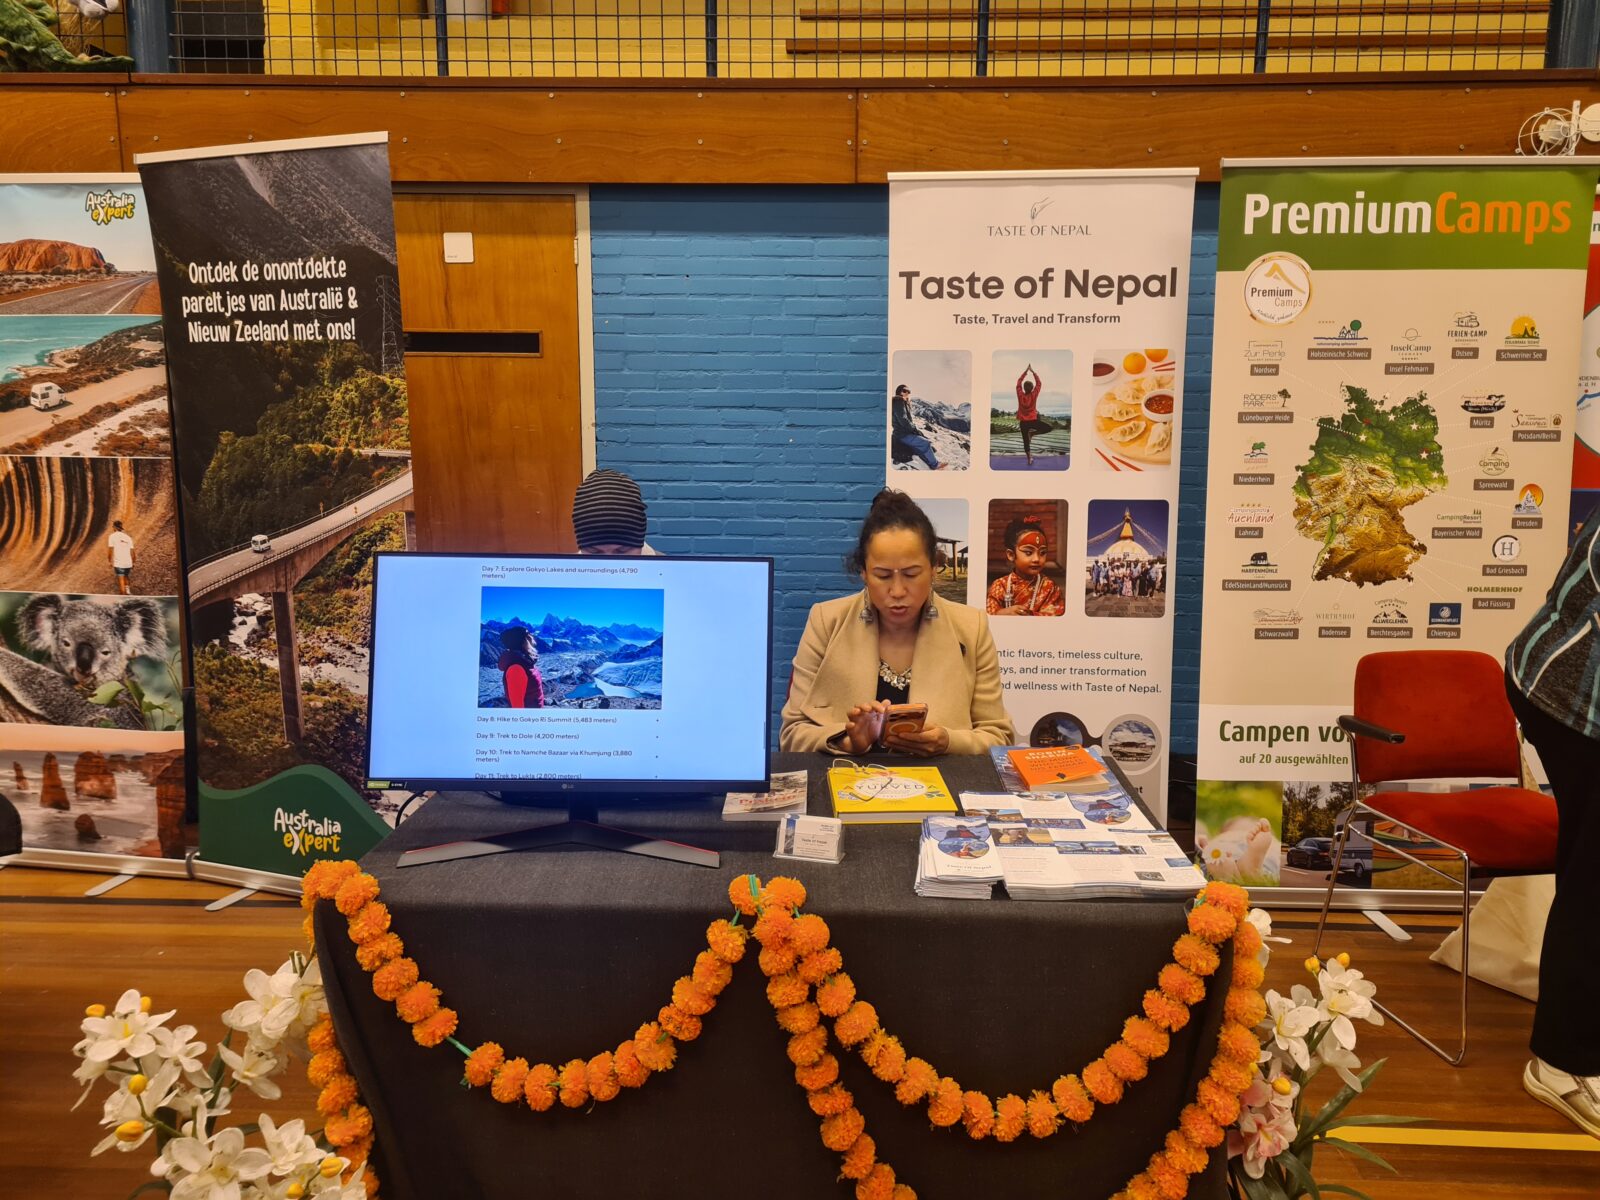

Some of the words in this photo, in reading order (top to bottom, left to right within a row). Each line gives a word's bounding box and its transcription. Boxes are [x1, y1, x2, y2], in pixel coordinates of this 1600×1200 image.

[85, 190, 135, 211] Australia
[988, 225, 1026, 237] TASTE
[1030, 224, 1048, 236] OF
[1050, 224, 1092, 236] NEPAL
[188, 262, 239, 284] Ontdek
[242, 260, 260, 282] de
[263, 256, 347, 280] onontdekte
[898, 271, 1004, 300] Taste
[1014, 267, 1054, 299] of
[1064, 266, 1178, 305] Nepal
[1251, 287, 1292, 298] Premium
[182, 290, 246, 318] pareltjes
[250, 292, 276, 312] van
[280, 287, 344, 311] Australië
[348, 286, 358, 310] &
[1274, 298, 1302, 308] Camps
[952, 314, 989, 326] Taste,
[992, 313, 1029, 324] Travel
[1031, 313, 1054, 324] and
[1057, 313, 1121, 324] Transform
[188, 321, 230, 343] Nieuw
[234, 319, 289, 342] Zeeland
[293, 318, 322, 341] met
[326, 317, 356, 341] ons!
[1310, 350, 1346, 358] Holsteinische
[1390, 344, 1432, 352] InselCamp
[1254, 366, 1276, 374] Nordsee
[1479, 460, 1510, 468] Camping
[1500, 542, 1514, 556] H
[1490, 600, 1510, 608] Füssing
[1018, 650, 1054, 659] flavors,
[1058, 650, 1101, 659] timeless
[1104, 650, 1143, 661] culture,
[1019, 666, 1038, 674] and
[1040, 666, 1066, 674] inner
[1069, 666, 1146, 676] transformation
[1014, 682, 1058, 690] wellness
[1060, 682, 1082, 690] with
[1085, 682, 1113, 692] Taste
[1115, 683, 1126, 692] of
[1128, 684, 1162, 694] Nepal.
[1219, 720, 1310, 748] Campen
[1318, 725, 1350, 742] vo
[1239, 753, 1256, 764] auf
[1258, 754, 1272, 764] 20
[1274, 753, 1348, 767] ausgewählten
[274, 808, 342, 836] Australia
